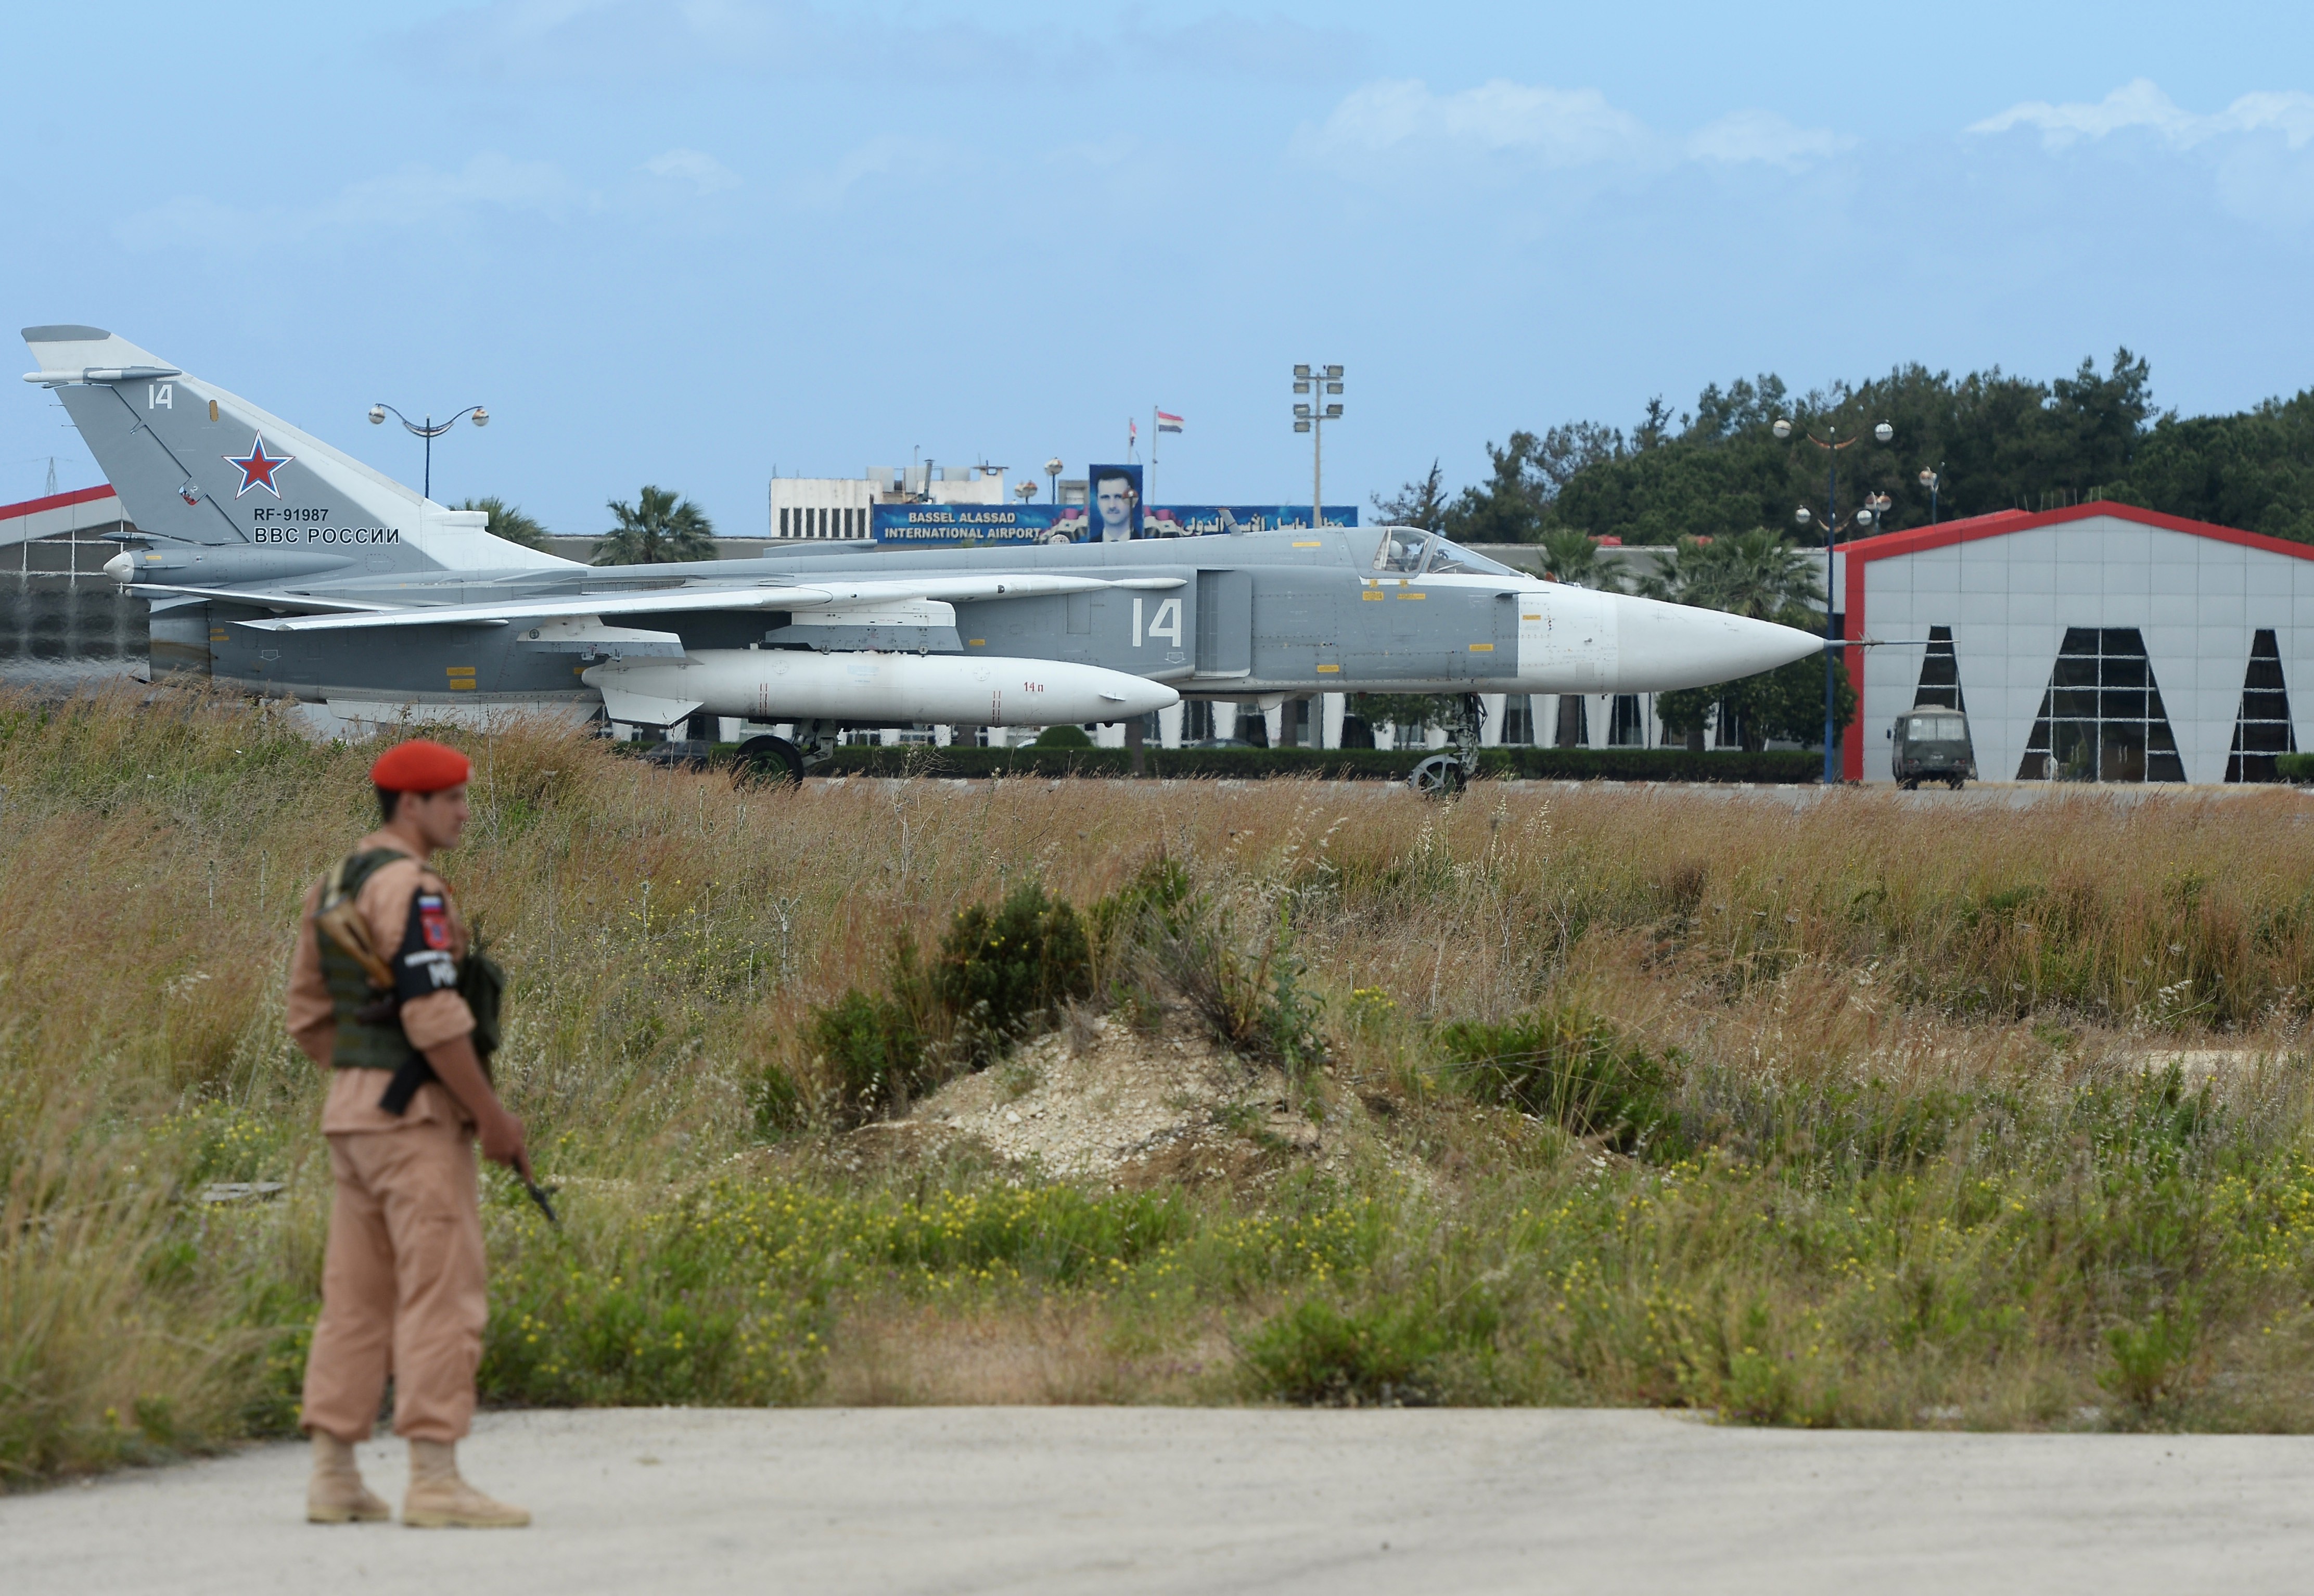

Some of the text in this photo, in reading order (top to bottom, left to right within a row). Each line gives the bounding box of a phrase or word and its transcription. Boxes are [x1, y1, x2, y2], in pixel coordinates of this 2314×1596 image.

[149, 384, 172, 409] 14
[254, 508, 329, 521] RF-91987
[909, 512, 1016, 524] BASSEL ALASSAD
[254, 527, 400, 545] ВВС РОССИИ
[885, 527, 1041, 539] INTERNATIONAL AIRPORT
[1132, 598, 1182, 647] 14
